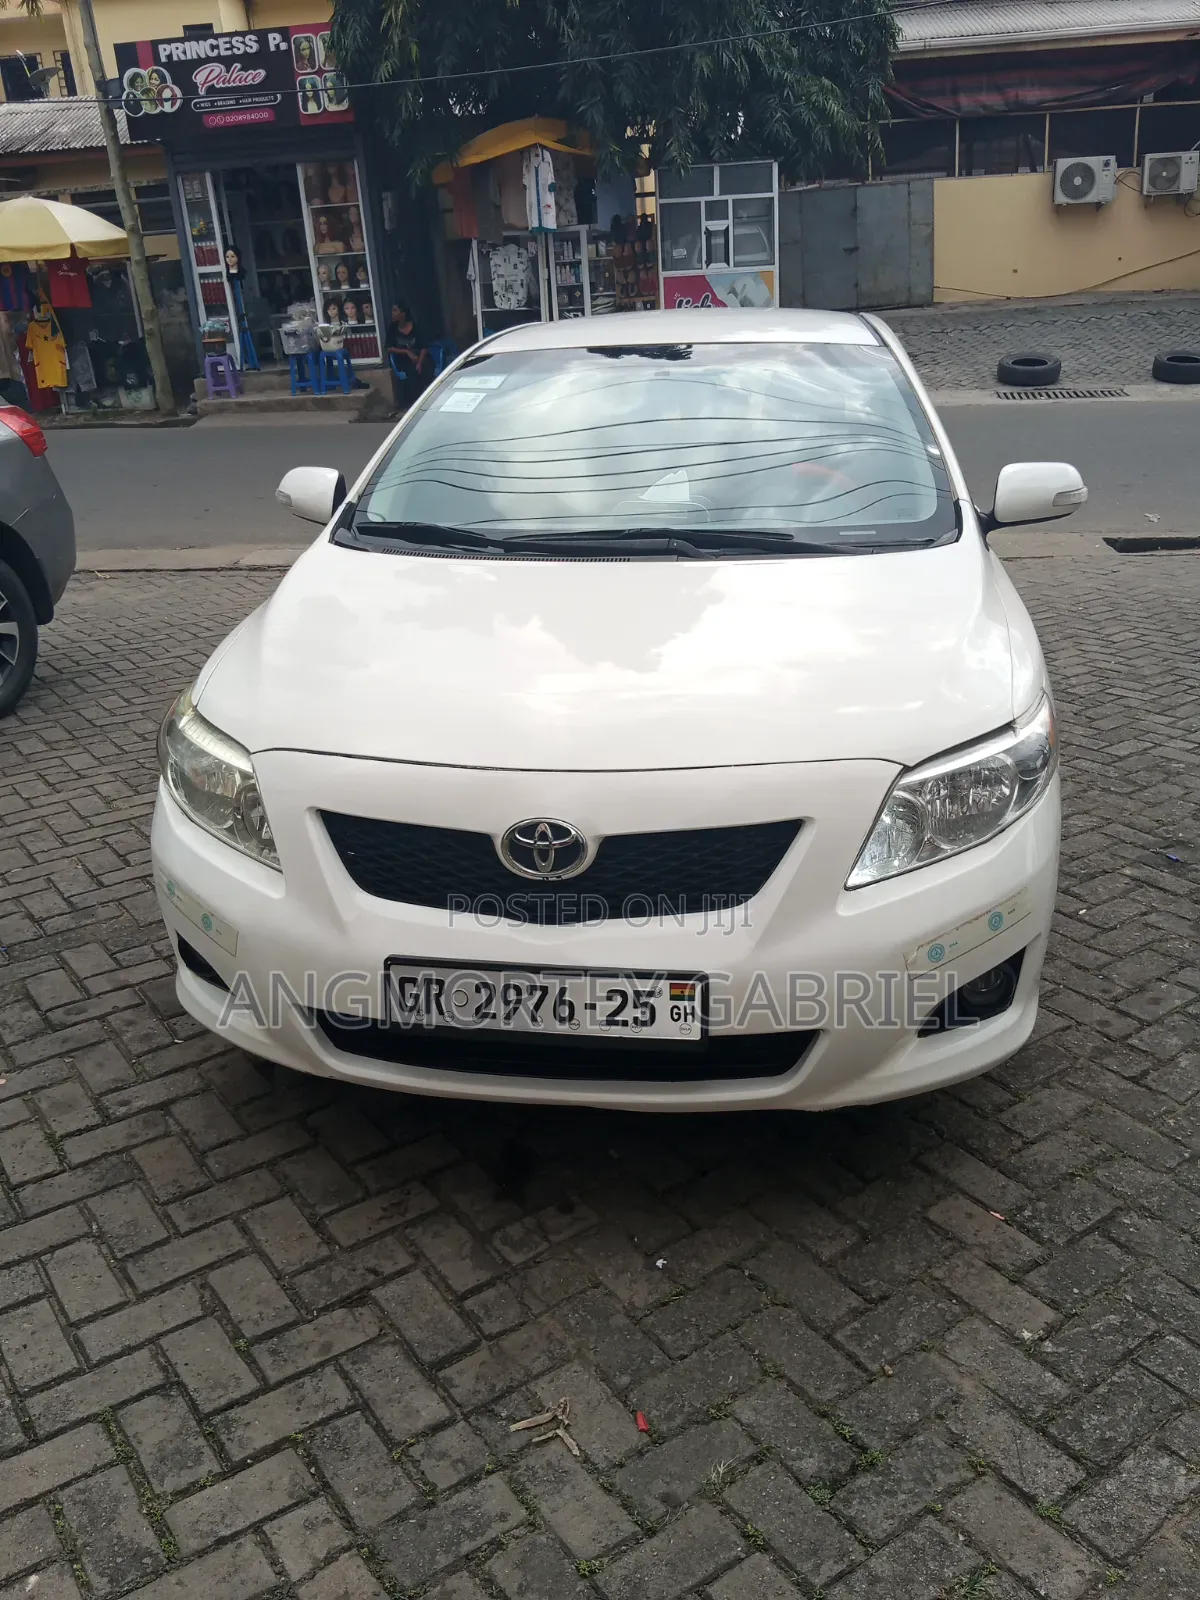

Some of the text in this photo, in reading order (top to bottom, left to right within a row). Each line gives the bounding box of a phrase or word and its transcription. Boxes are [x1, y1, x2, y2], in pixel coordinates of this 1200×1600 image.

[158, 35, 259, 62] PRINCESS
[192, 62, 267, 95] Palace
[399, 976, 446, 1016] GR
[670, 1004, 696, 1023] GH
